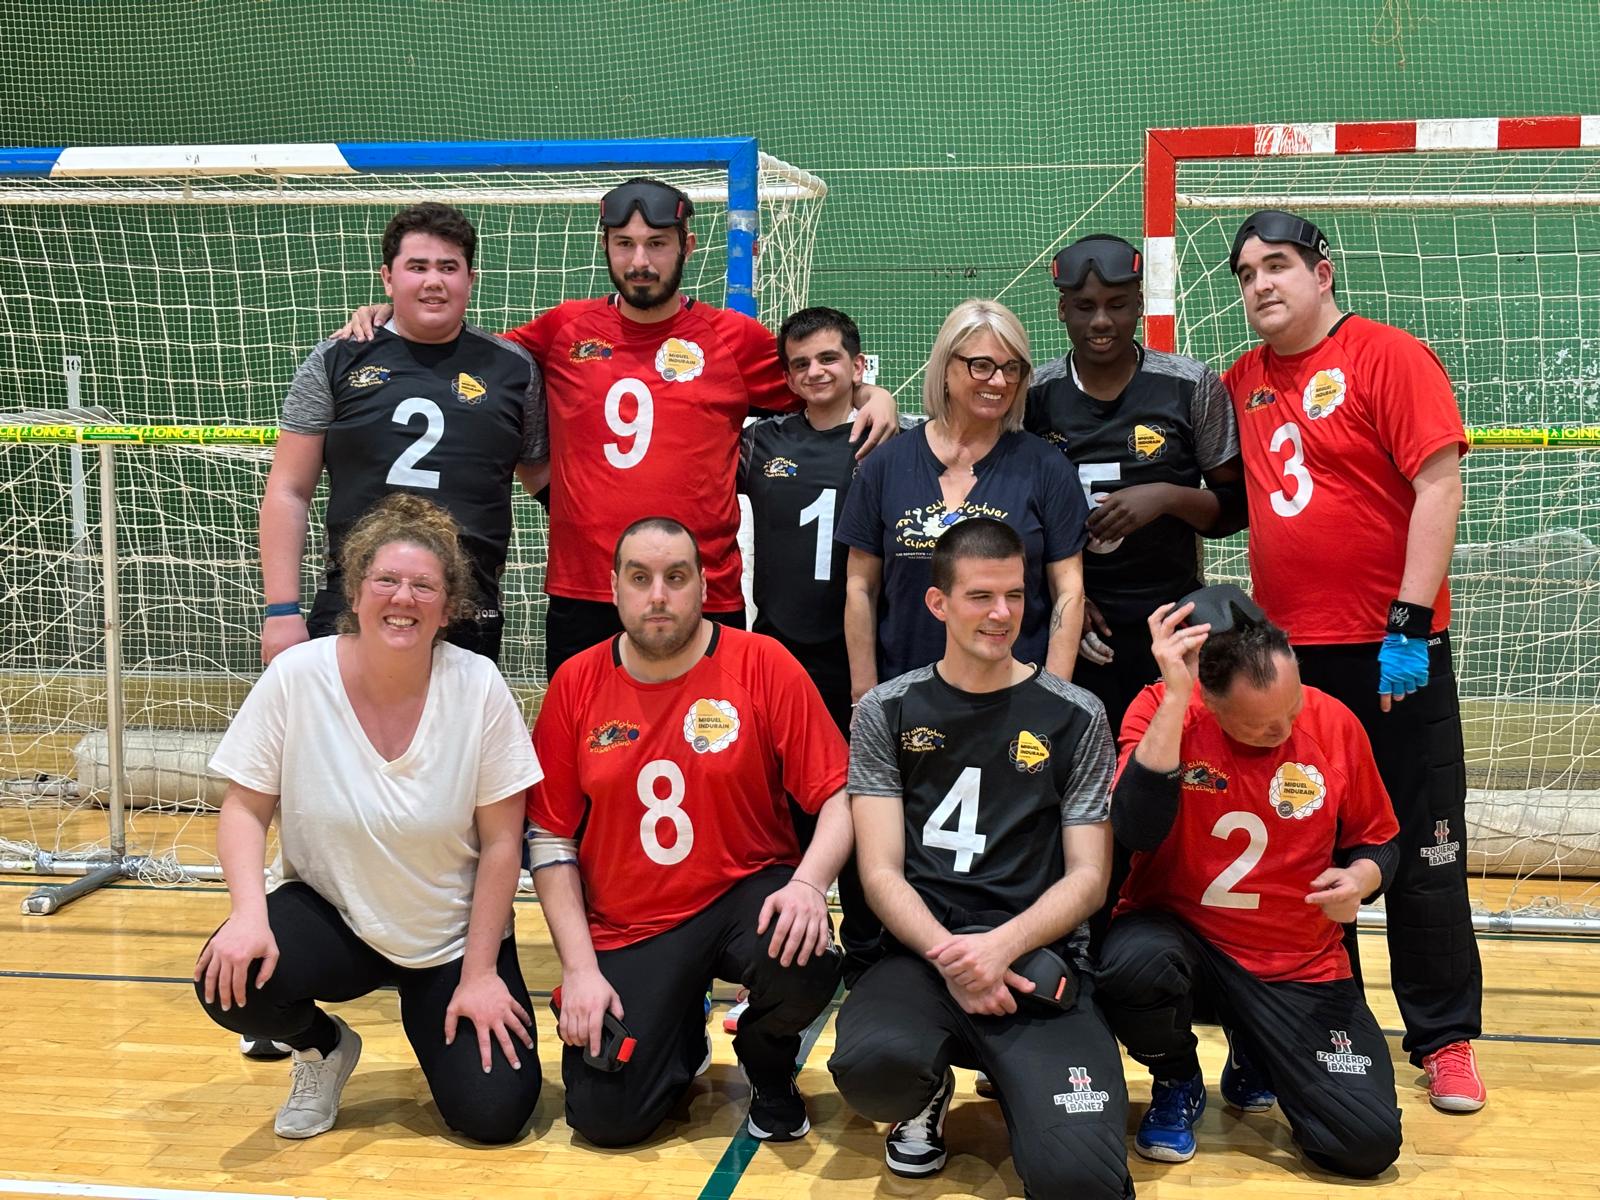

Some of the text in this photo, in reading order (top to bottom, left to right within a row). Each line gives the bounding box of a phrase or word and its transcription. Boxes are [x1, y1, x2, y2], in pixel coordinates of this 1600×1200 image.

[155, 426, 199, 438] ONCE
[385, 397, 445, 490] 2
[603, 377, 654, 469] 9
[1269, 421, 1314, 518] 3
[799, 488, 837, 581] 1
[636, 759, 694, 865] 8
[922, 766, 987, 873] 4
[1200, 811, 1269, 910] 2
